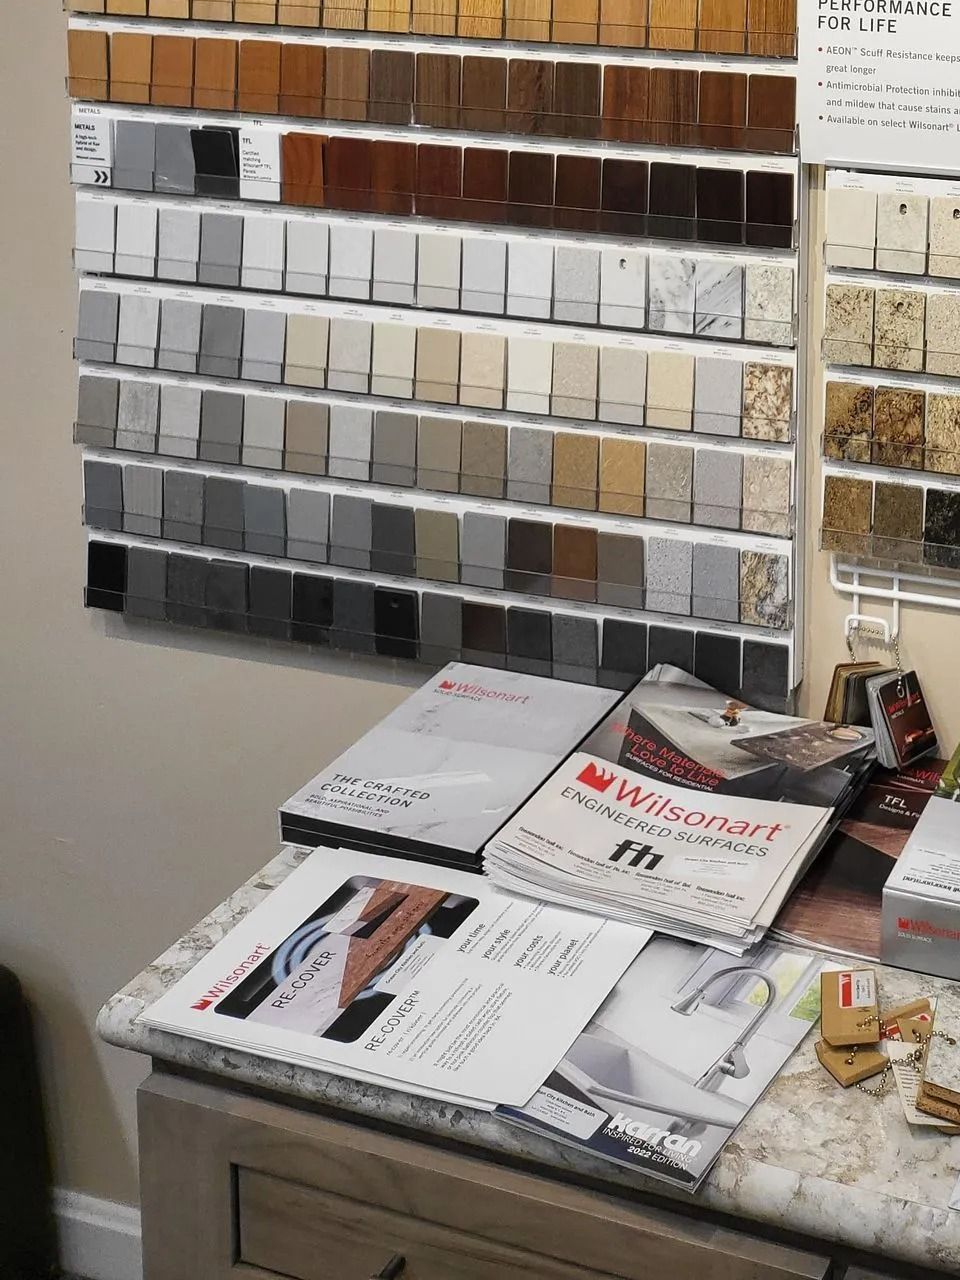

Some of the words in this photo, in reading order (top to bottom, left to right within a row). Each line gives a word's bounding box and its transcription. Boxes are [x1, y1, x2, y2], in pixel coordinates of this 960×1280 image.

[817, 15, 851, 31] FOR
[859, 18, 897, 33] LIFE
[826, 63, 847, 74] great
[850, 64, 877, 75] longer
[860, 47, 883, 58] Scuff
[886, 49, 933, 61] Resistance
[935, 52, 960, 65] keeps
[826, 80, 883, 93] Antimicrobial
[886, 83, 930, 96] Protection
[826, 97, 842, 107] and
[845, 98, 876, 110] mildew
[878, 100, 895, 110] that
[898, 102, 923, 113] cause
[925, 104, 951, 115] stains
[826, 114, 865, 126] Available
[867, 117, 878, 126] on
[880, 117, 906, 129] select
[456, 682, 531, 704] Wilsonart
[625, 753, 659, 773] SURFACES
[659, 768, 673, 780] FOR
[673, 775, 714, 791] RESIDENTIAL
[631, 744, 667, 768] Love
[670, 764, 685, 776] to
[687, 769, 720, 786] Live
[320, 783, 413, 808] COLLECTION
[332, 774, 362, 786] THE
[363, 781, 430, 800] CRAFTED
[615, 779, 785, 842] Wilsonart
[885, 794, 907, 808] TFL
[561, 786, 672, 838] ENGINEERED
[673, 831, 770, 858] SURFACES
[457, 936, 471, 953] your
[469, 923, 486, 938] time
[482, 943, 497, 960] your
[495, 929, 511, 945] style
[514, 951, 529, 968] your
[526, 935, 544, 952] costs
[547, 959, 562, 976] your
[560, 939, 579, 960] planet
[271, 951, 337, 1009] RE-COVER
[602, 1127, 642, 1146] INSPIRED
[642, 1141, 662, 1153] FOR
[607, 1111, 702, 1157] Karran
[627, 1145, 651, 1158] 2022
[652, 1153, 689, 1170] EDITION
